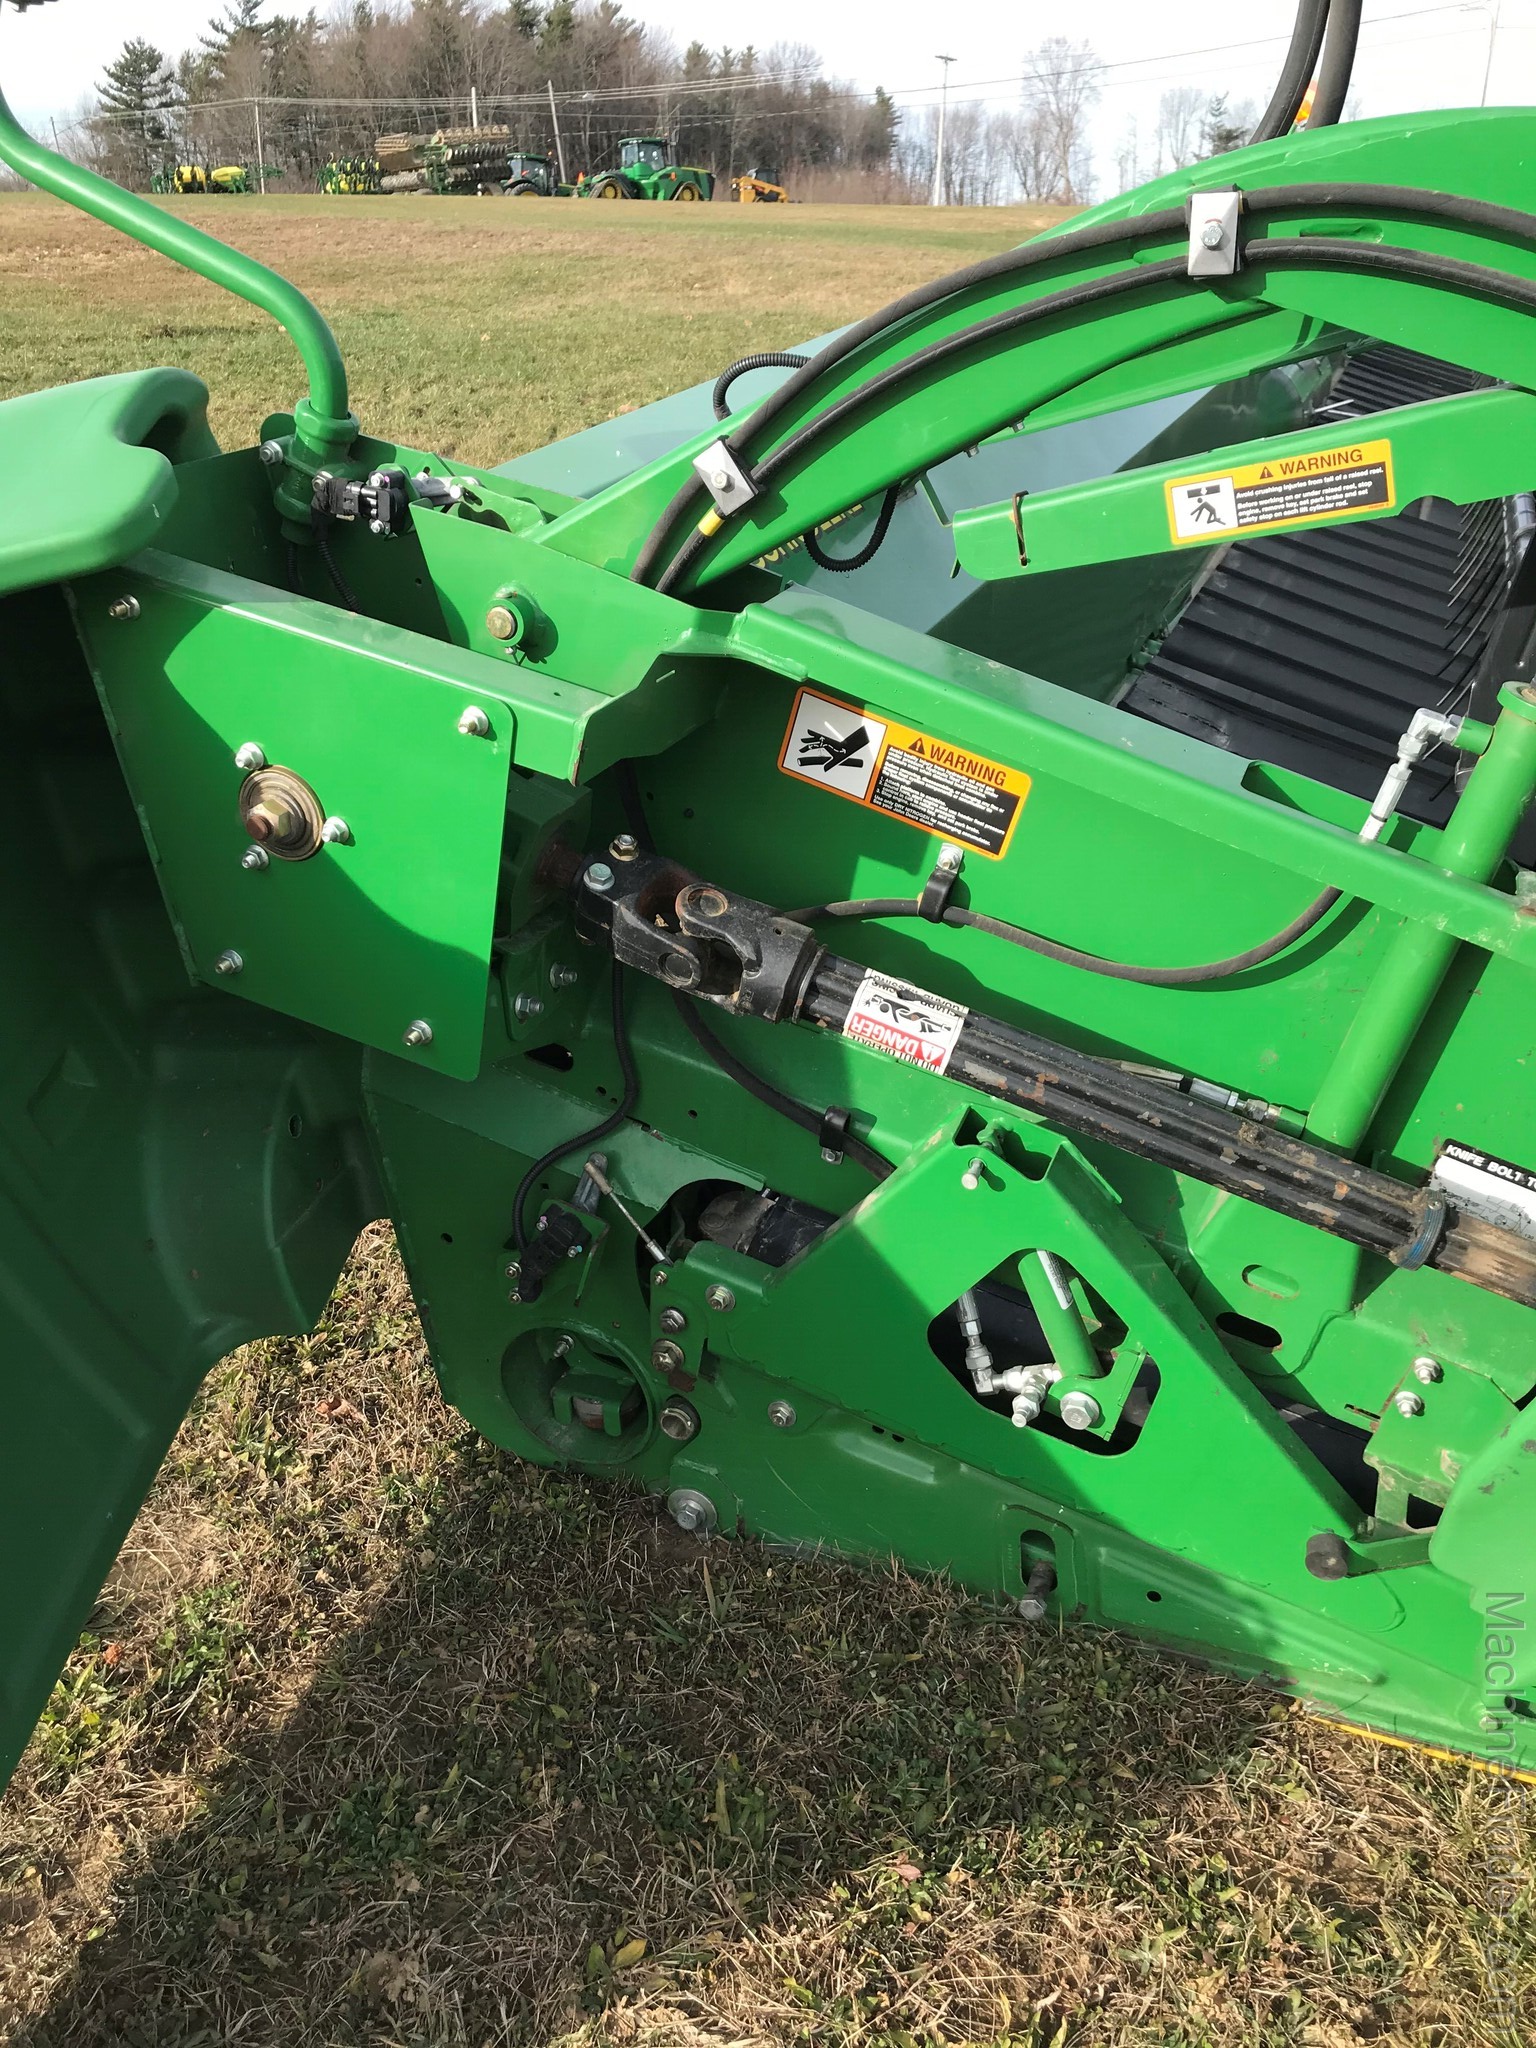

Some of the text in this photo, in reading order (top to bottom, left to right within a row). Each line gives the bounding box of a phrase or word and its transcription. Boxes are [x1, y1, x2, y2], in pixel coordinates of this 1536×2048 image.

[1279, 448, 1363, 475] WARNING
[1236, 490, 1253, 498] Avoid
[1254, 484, 1282, 496] crushing
[1283, 480, 1306, 491] injuries
[1307, 477, 1322, 485] from
[1348, 469, 1368, 478] raised
[1369, 466, 1383, 474] reel.
[1237, 500, 1257, 509] Before
[1258, 495, 1283, 506] working
[1302, 489, 1321, 497] under
[1321, 485, 1341, 494] raised
[1357, 479, 1372, 489] stop
[1238, 507, 1261, 518] engine,
[1262, 504, 1284, 512] remove
[1285, 500, 1298, 509] key,
[1310, 496, 1324, 504] park
[1325, 492, 1343, 501] brake
[1239, 515, 1258, 525] safety
[1259, 512, 1273, 521] stop
[1283, 507, 1298, 515] each
[1309, 501, 1334, 512] cylinder
[889, 746, 903, 755] Avoid
[930, 744, 1007, 786] WARNING
[881, 790, 892, 798] Stop
[885, 778, 900, 787] Attach
[883, 798, 893, 806] only
[905, 807, 929, 819] NITROGEN
[893, 806, 904, 814] John
[905, 811, 918, 820] Deere
[919, 817, 934, 826] dealer.
[849, 1015, 920, 1055] DANGER
[1445, 1144, 1486, 1167] KNIFE
[1487, 1161, 1522, 1182] BOLT
